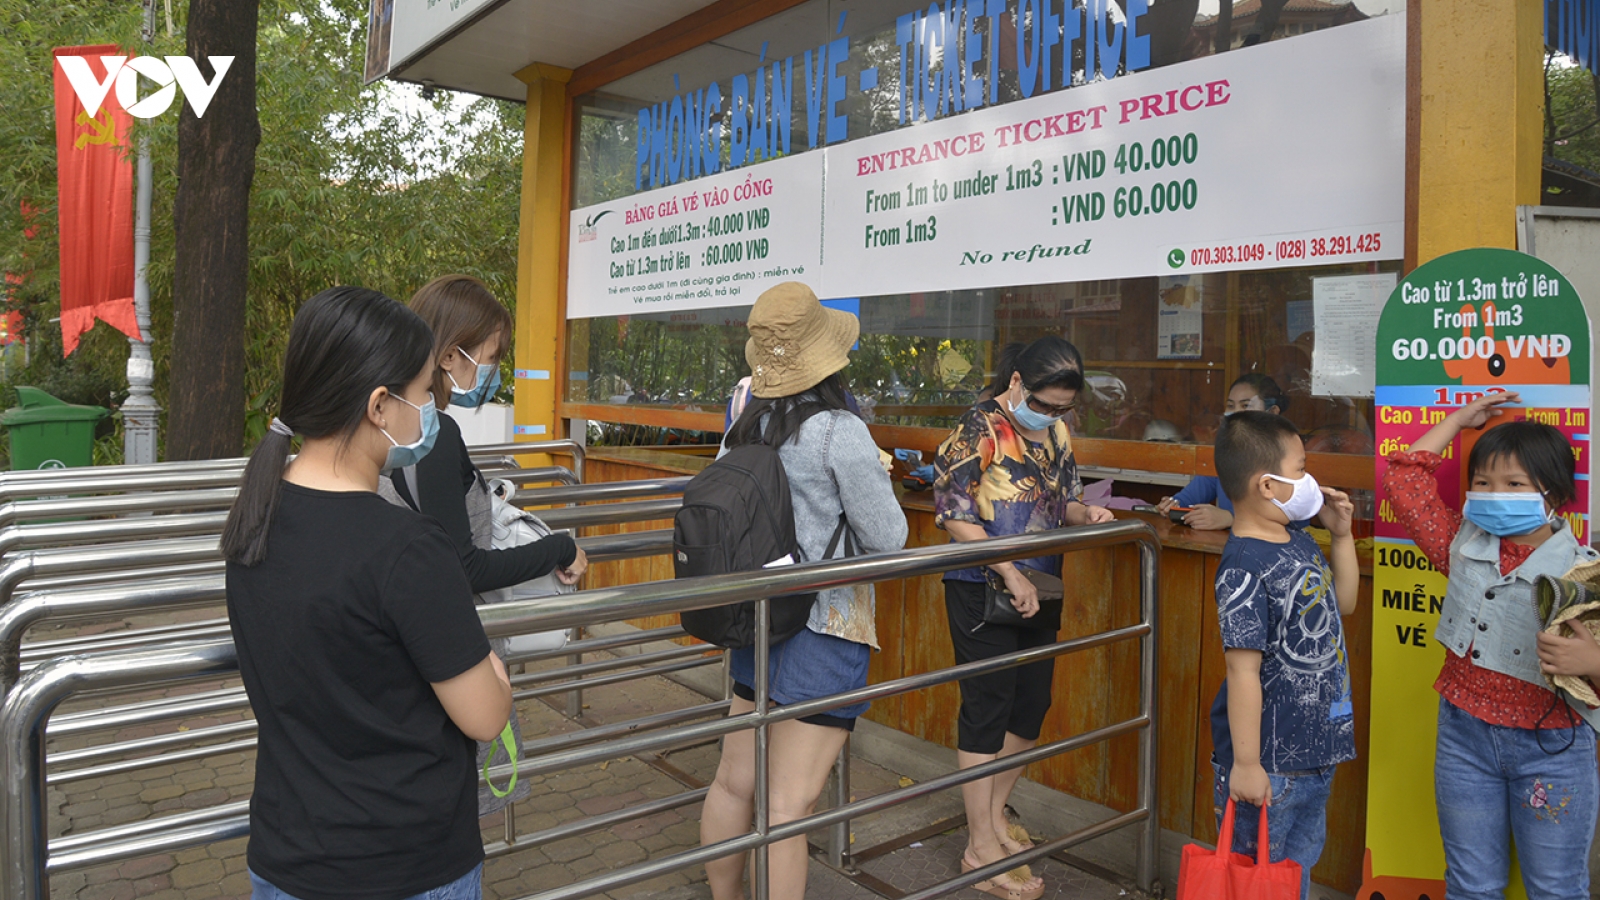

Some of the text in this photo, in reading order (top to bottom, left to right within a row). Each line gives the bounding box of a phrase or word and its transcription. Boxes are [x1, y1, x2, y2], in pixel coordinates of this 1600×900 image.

[635, 73, 721, 190] PHÒNG
[731, 41, 793, 170] BÁN
[805, 10, 850, 148] VÉ
[896, 0, 1006, 125] TICKET
[1016, 0, 1151, 98] OFFICE
[857, 79, 1231, 176] ENTRANCE TICKET PRICE
[866, 187, 902, 214] From
[906, 183, 928, 208] 1m
[933, 179, 947, 203] to
[953, 170, 998, 201] under
[1006, 160, 1043, 192] 1m3
[1113, 132, 1198, 176] 40.000
[625, 173, 773, 225] BẢNG GIÁ VÉ VÀO CỔNG
[865, 222, 900, 249] From
[905, 215, 937, 244] 1m3
[1112, 178, 1198, 219] 60.000
[611, 236, 625, 254] Cao
[628, 234, 640, 251] 1m
[641, 227, 657, 248] đến
[747, 207, 770, 230] VNĐ
[610, 261, 624, 279] Cao
[626, 259, 636, 276] từ
[638, 256, 658, 275] 1.3m
[660, 251, 674, 271] trở
[676, 251, 690, 268] lên
[746, 238, 769, 260] VNĐ
[960, 238, 1092, 266] No refund
[1190, 243, 1265, 267] 070.303.1049
[1275, 239, 1307, 262] (028)
[1310, 233, 1382, 257] 38.291.425
[680, 278, 691, 288] (đi
[692, 276, 714, 287] cùng
[716, 274, 730, 285] gia
[733, 271, 756, 282] đình)
[791, 264, 805, 275] vé
[1402, 271, 1559, 304] Cao từ 1.3m trở lên
[633, 295, 643, 304] Vé
[645, 295, 662, 303] mua
[715, 287, 727, 296] trả
[729, 286, 741, 296] lại
[1434, 304, 1523, 329] From 1m3
[1392, 333, 1571, 360] 60.000 VNĐ
[1380, 405, 1447, 425] Cao 1m
[1525, 407, 1585, 426] From 1m
[1382, 583, 1446, 615] MIỄN
[1396, 623, 1427, 648] VÉ
